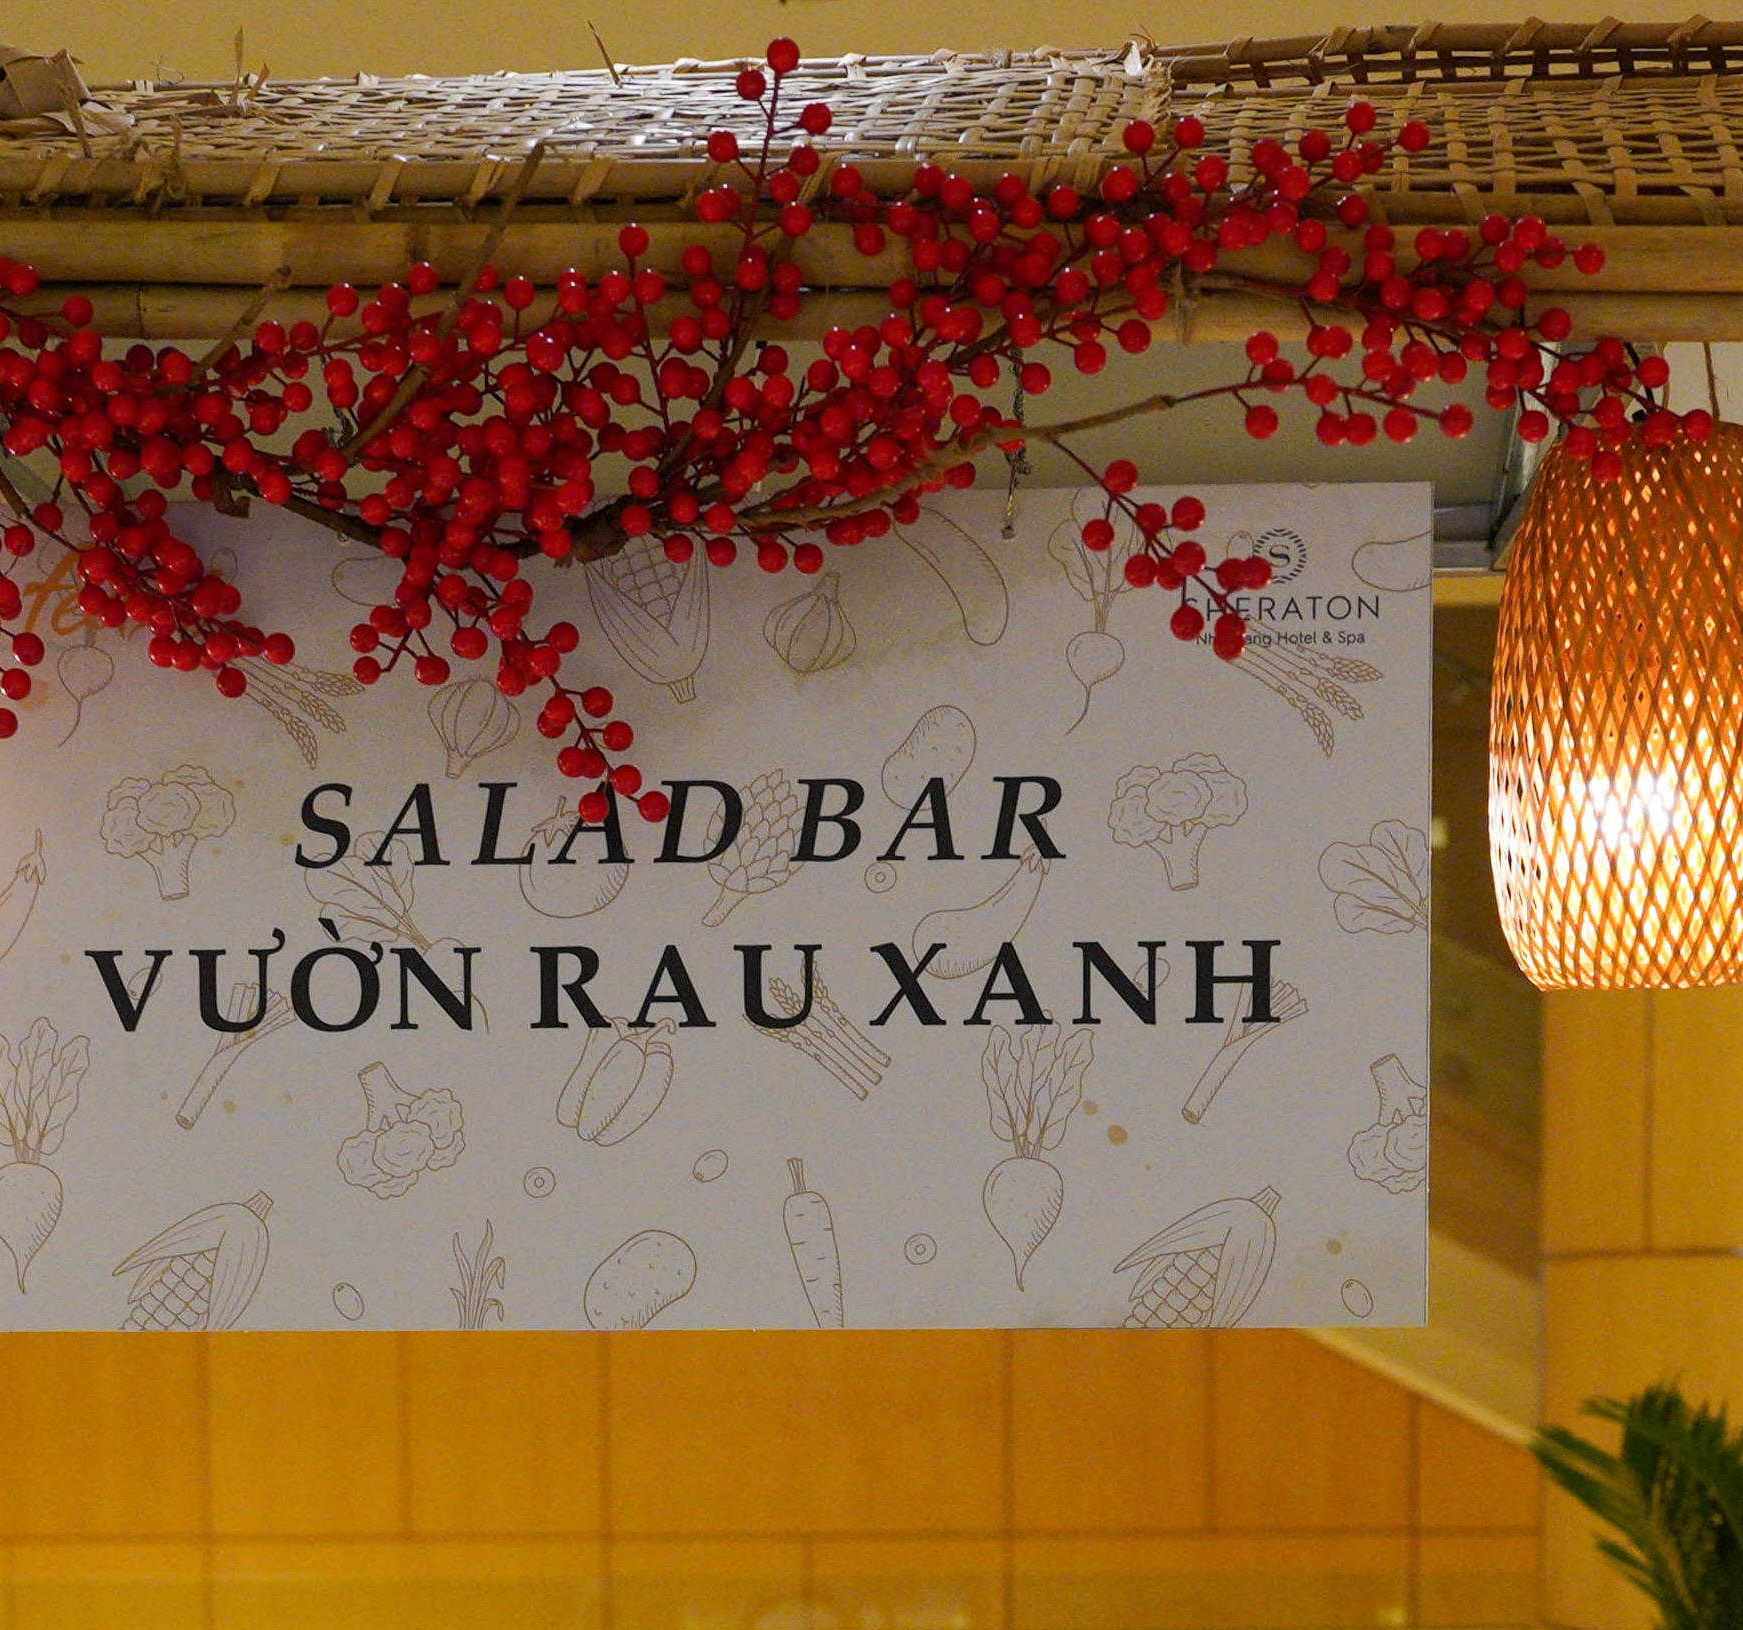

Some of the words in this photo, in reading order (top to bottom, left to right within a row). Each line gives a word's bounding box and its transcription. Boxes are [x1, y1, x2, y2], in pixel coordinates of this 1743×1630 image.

[1277, 631, 1316, 644] Hotel
[1323, 632, 1332, 644] &
[1339, 632, 1365, 646] Spa
[293, 780, 746, 870] SALAD
[790, 775, 1069, 864] BAR
[87, 916, 482, 1034] VƯỜN
[531, 943, 823, 1032] RAU
[869, 940, 1280, 1030] XANH
